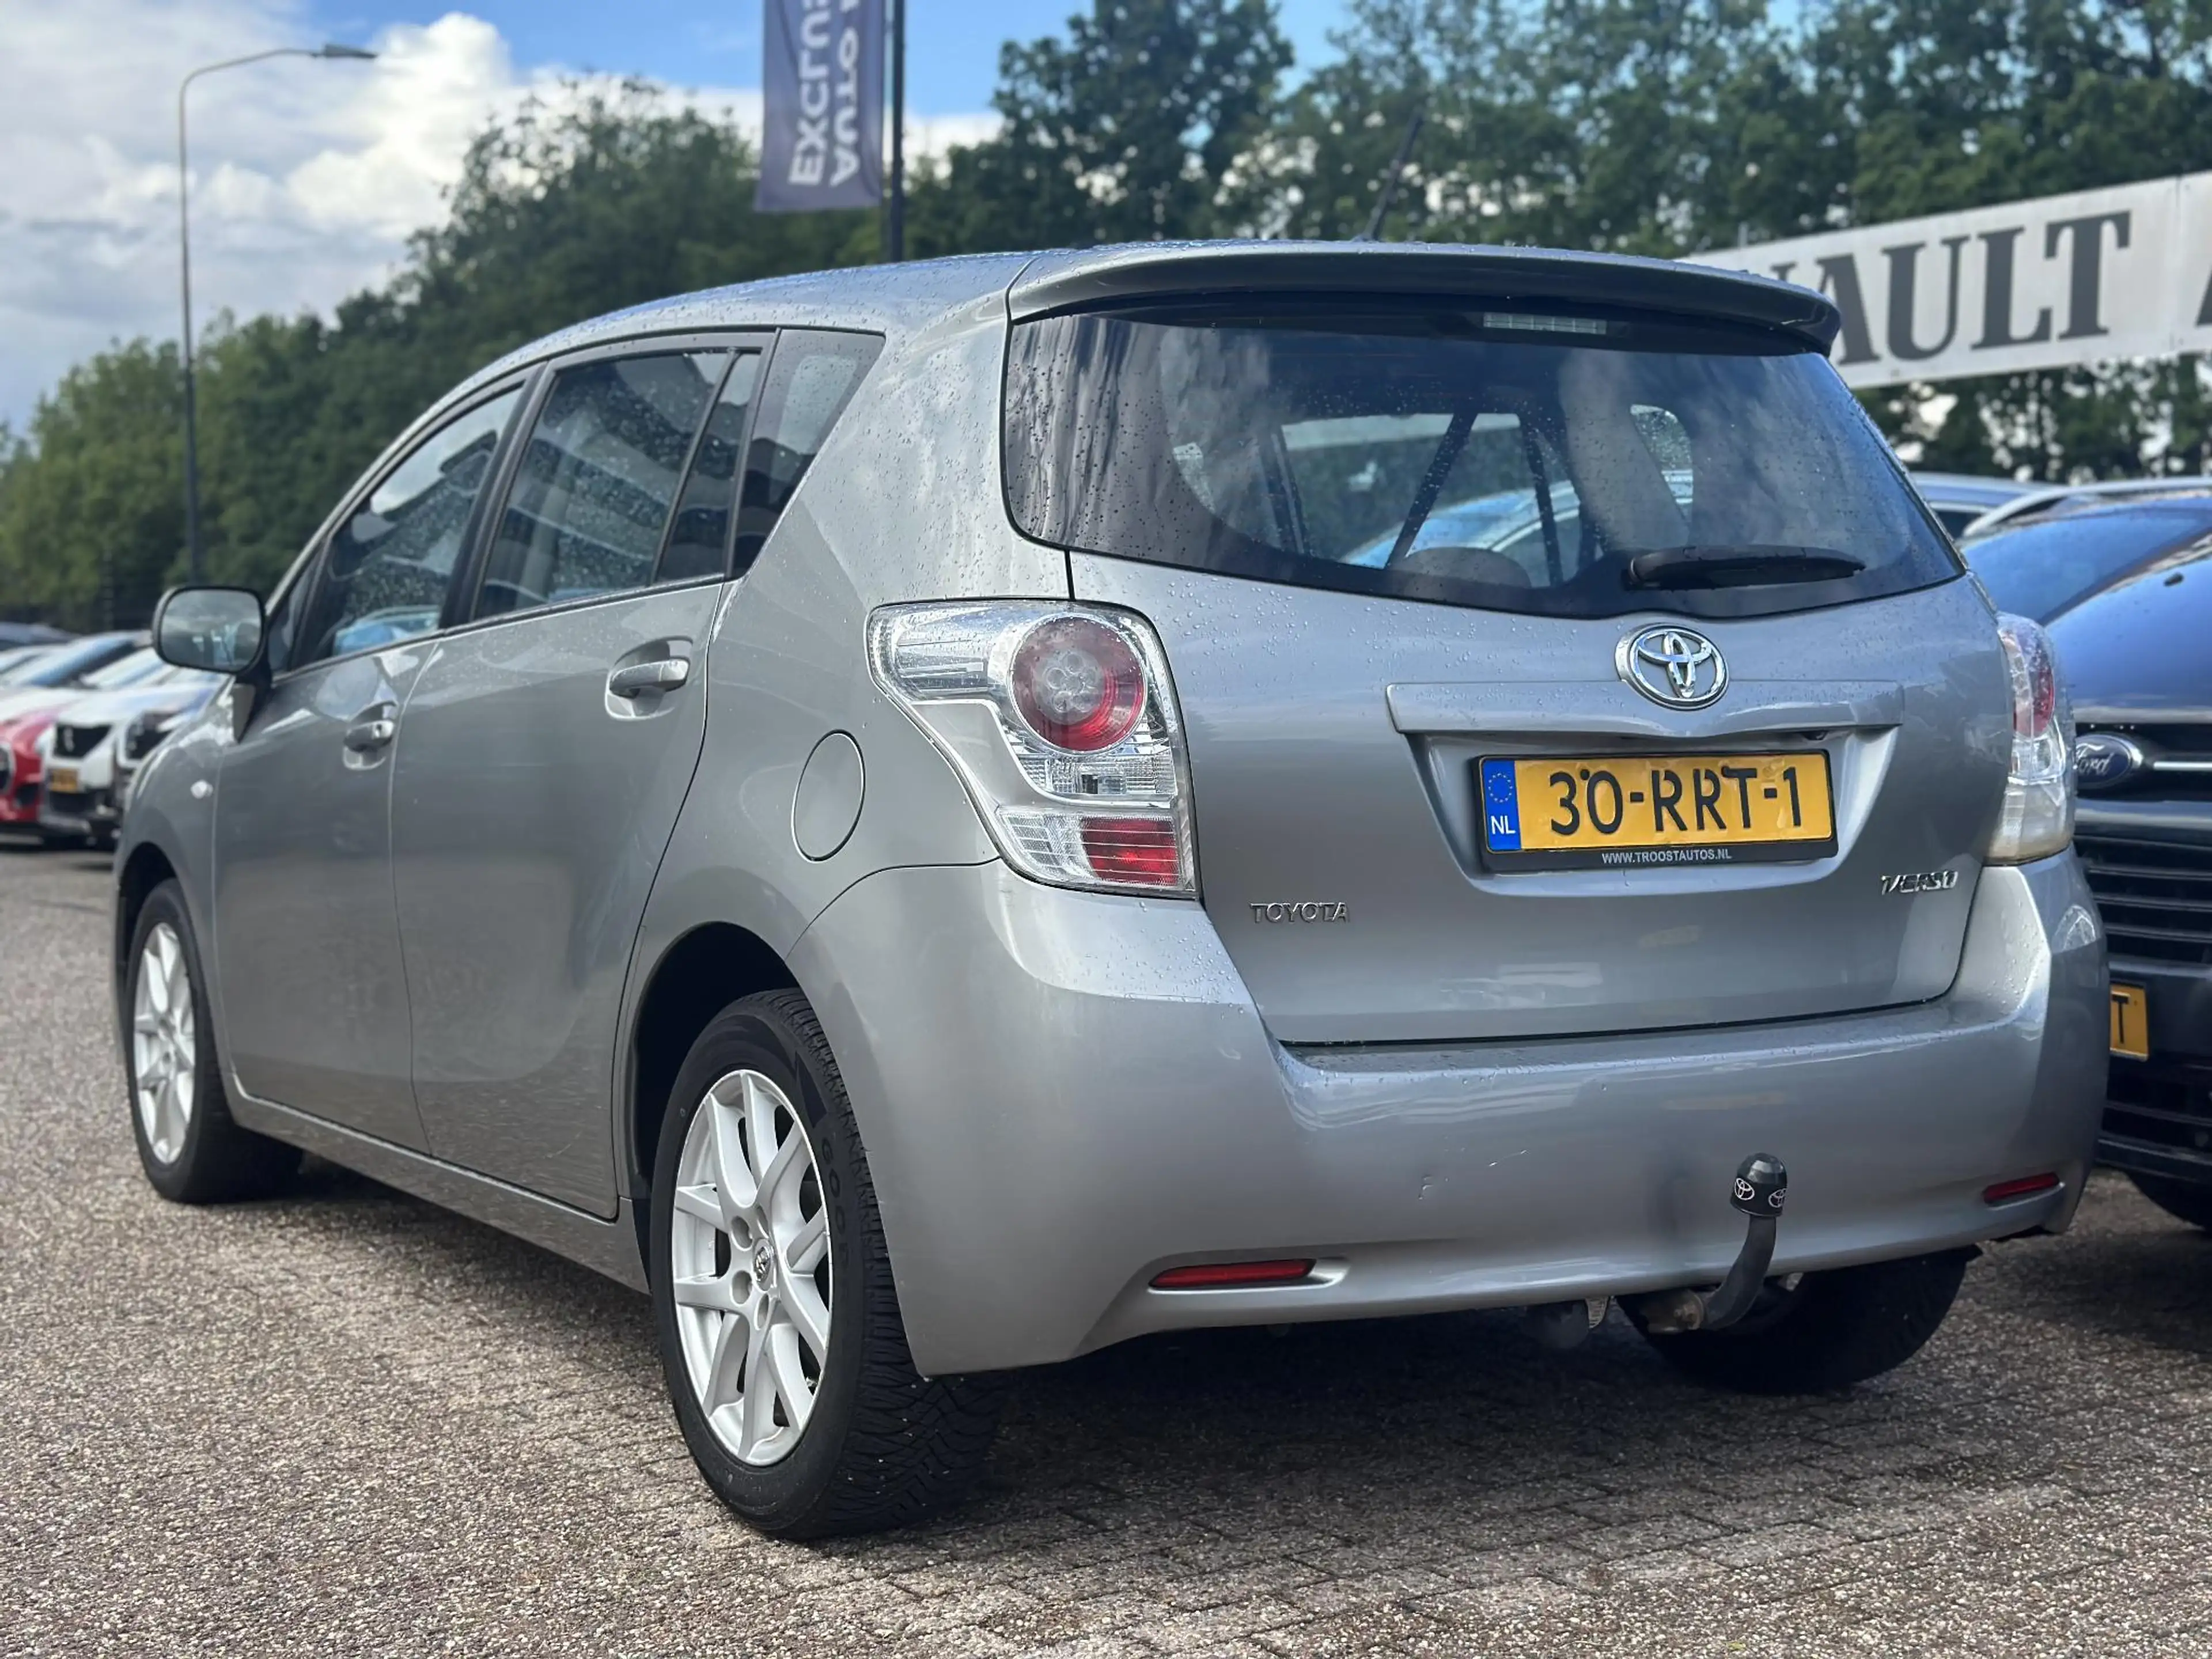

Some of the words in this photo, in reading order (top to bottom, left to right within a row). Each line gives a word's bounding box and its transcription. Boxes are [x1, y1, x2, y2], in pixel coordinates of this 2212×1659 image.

[1770, 210, 2131, 365] AULT
[1549, 766, 1801, 836] 30-RRT-1
[1491, 816, 1516, 835] NL
[1601, 848, 1733, 864] WWW.TROOSTAUTOS.NL
[1249, 902, 1350, 923] TOYOTA
